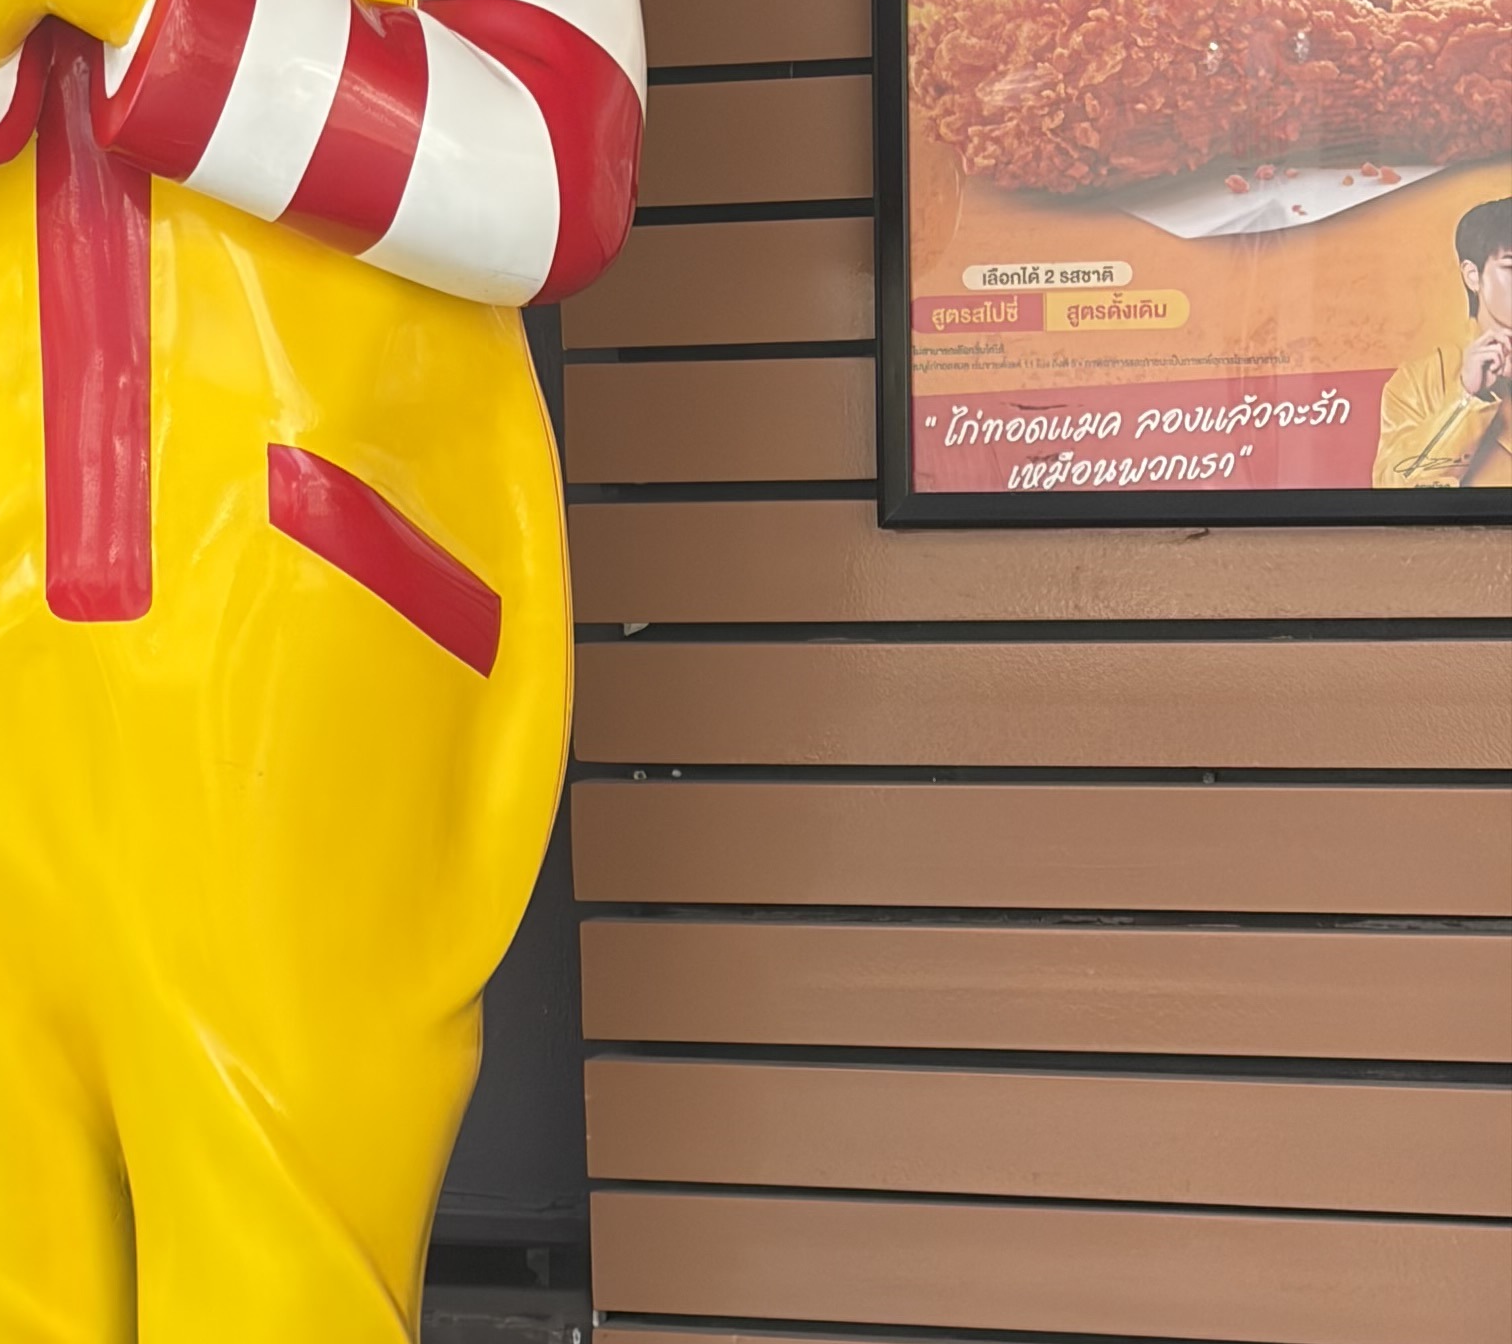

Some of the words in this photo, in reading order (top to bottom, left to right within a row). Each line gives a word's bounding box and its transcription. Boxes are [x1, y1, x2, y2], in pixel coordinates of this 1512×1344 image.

[982, 266, 1040, 287] เลือกได้
[1044, 269, 1055, 285] 2
[1060, 265, 1114, 284] รสชาติ
[931, 295, 1019, 332] สูตรสไปซี่
[1066, 292, 1168, 328] สูตรดั้งเดิม
[1134, 388, 1351, 440] ลองแล้วจะรัก
